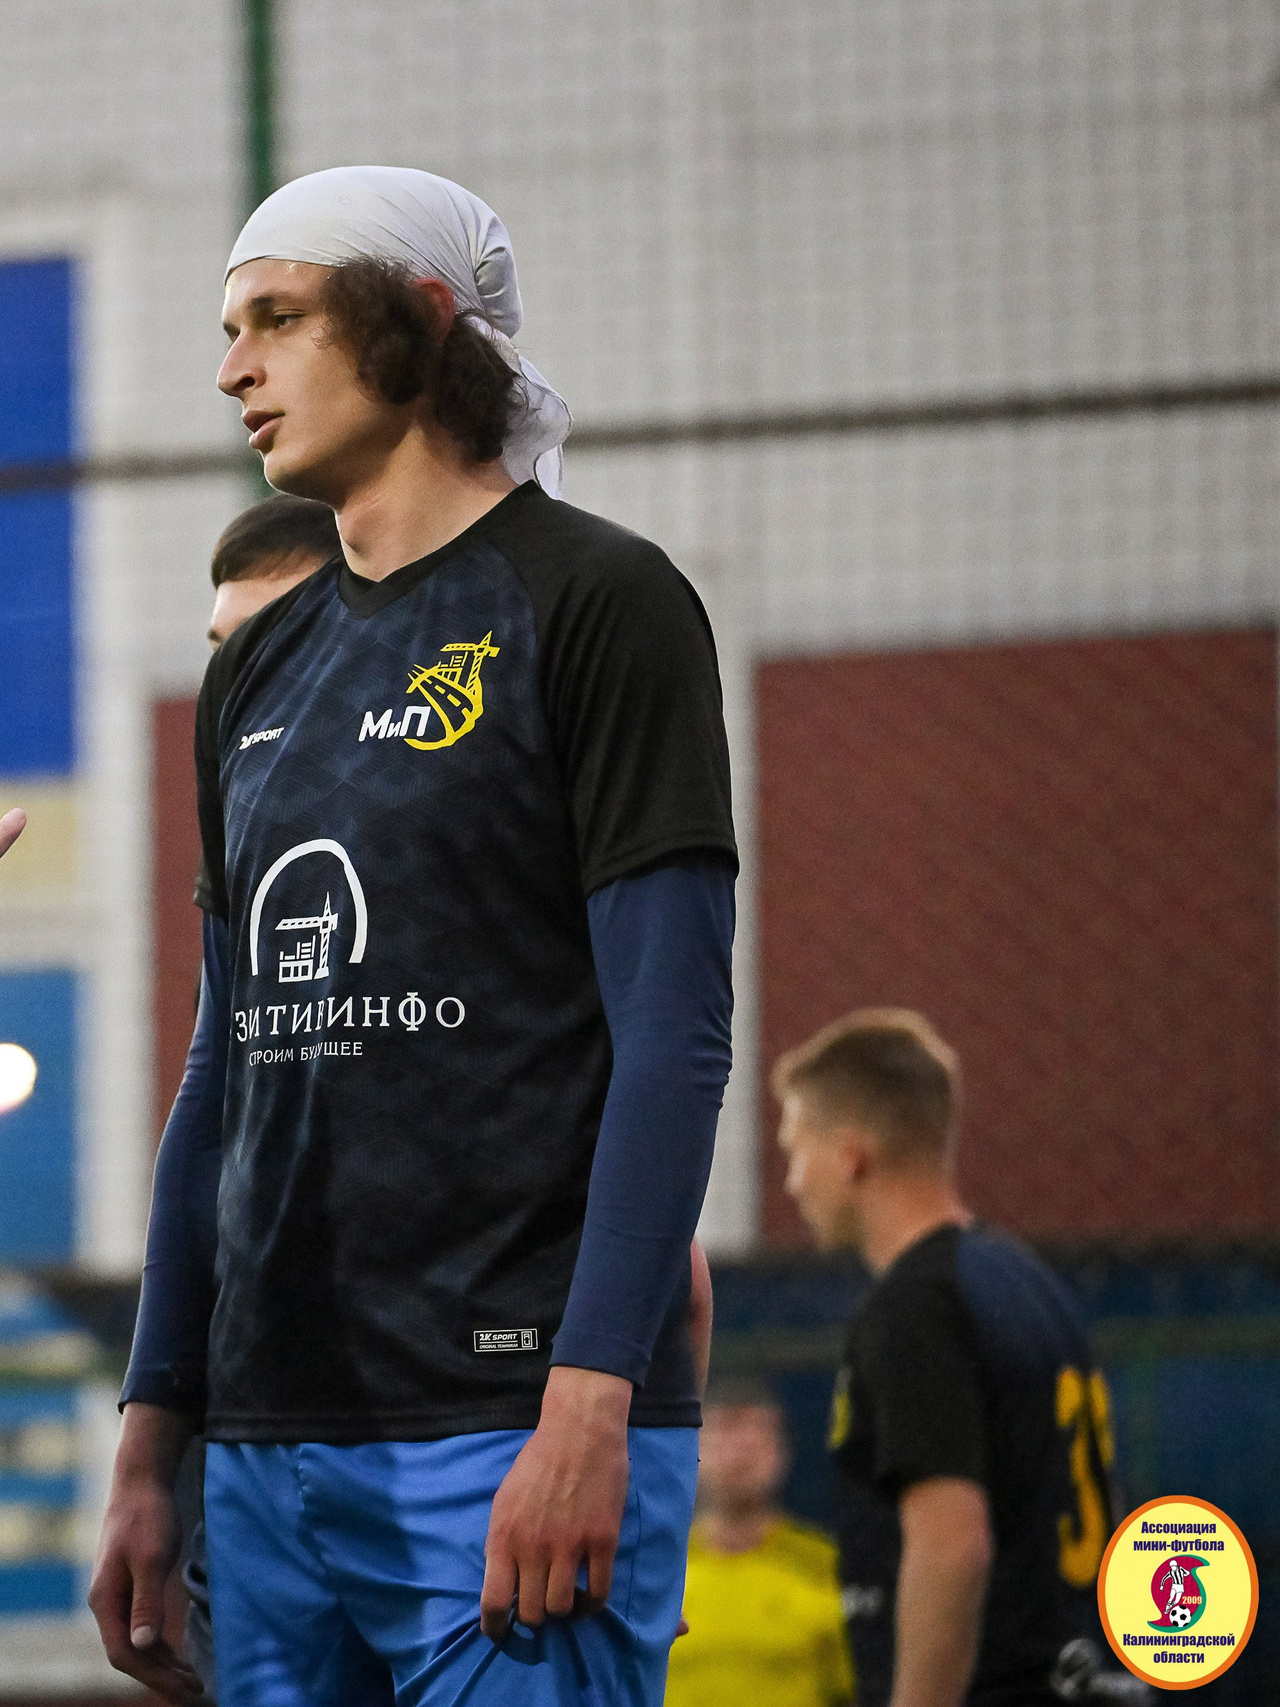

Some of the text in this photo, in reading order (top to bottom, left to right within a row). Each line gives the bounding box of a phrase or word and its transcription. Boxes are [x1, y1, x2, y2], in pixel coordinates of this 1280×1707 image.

[358, 705, 432, 742] МиП
[248, 1048, 294, 1067] СТРОИМ
[479, 1333, 518, 1342] 2K SPORT
